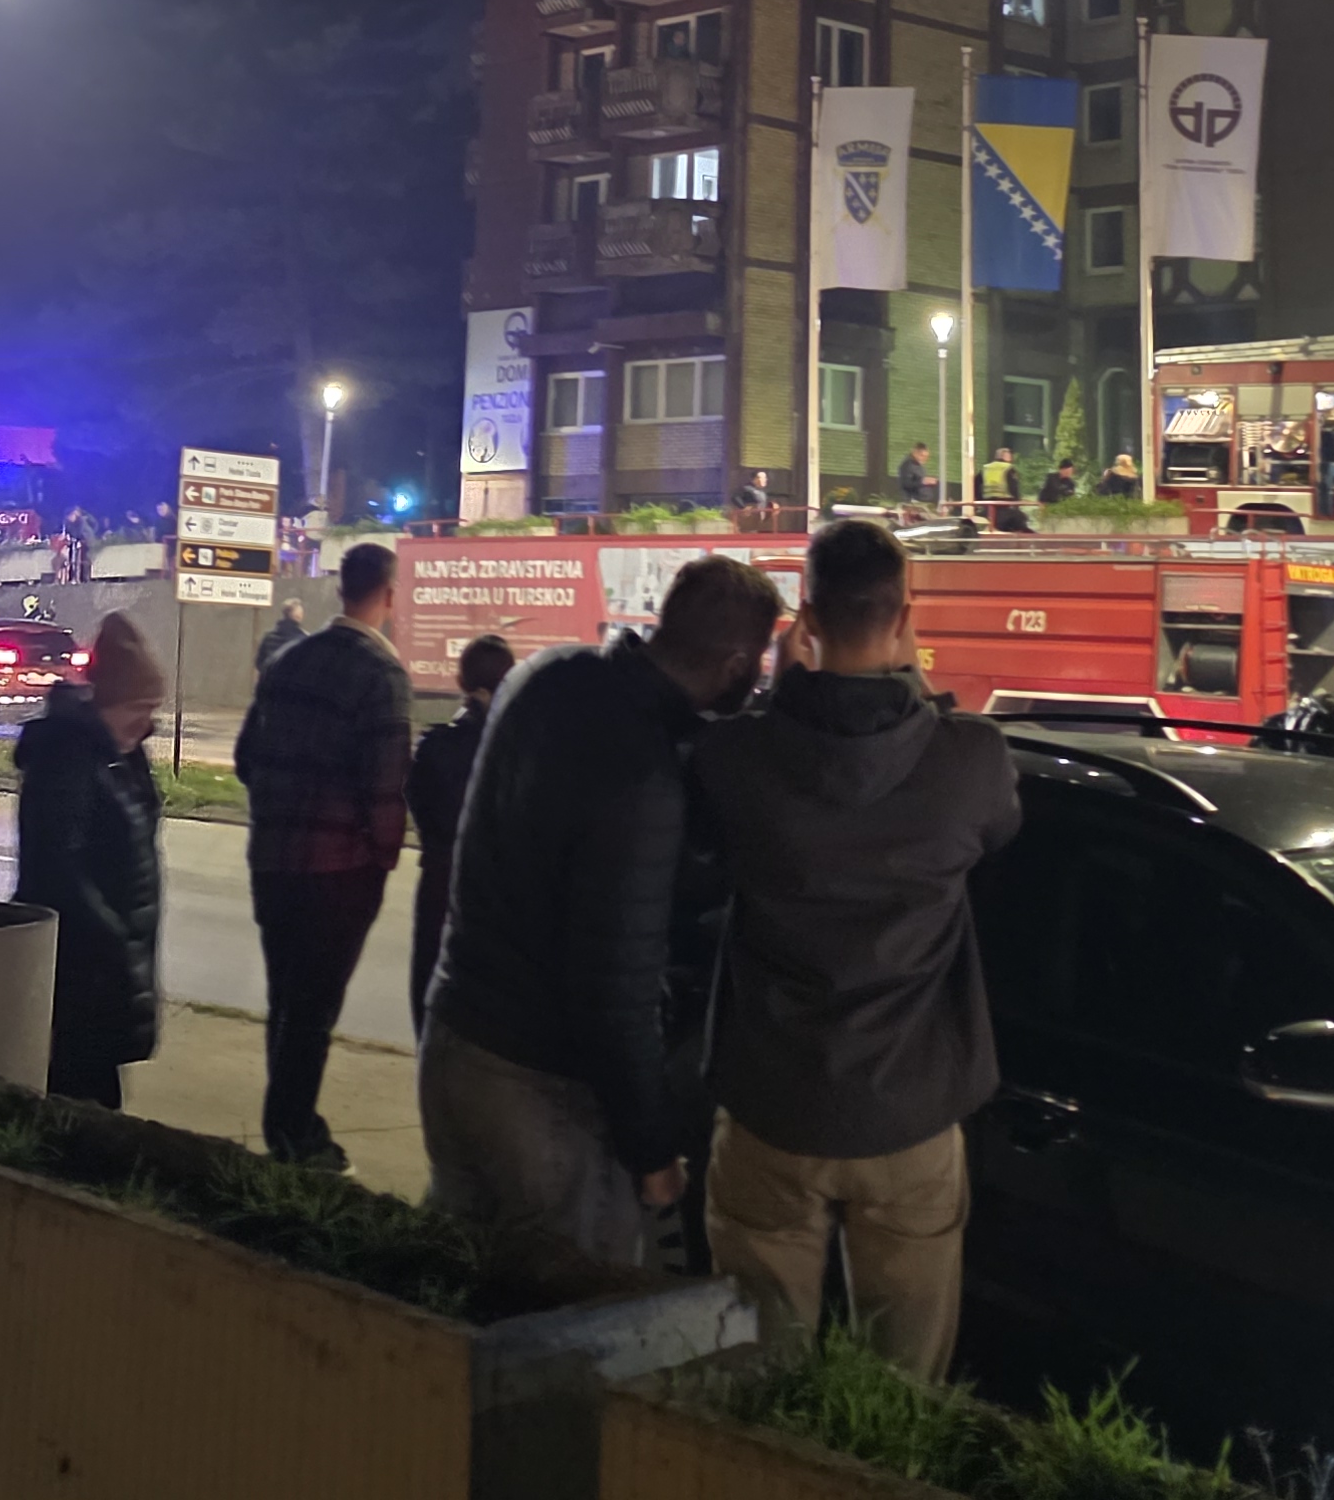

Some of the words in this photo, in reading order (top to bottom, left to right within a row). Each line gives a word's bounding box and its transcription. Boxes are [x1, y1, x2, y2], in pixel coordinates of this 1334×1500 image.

[496, 364, 528, 383] DOM
[472, 391, 530, 410] PENZION
[478, 560, 584, 579] ZDRAVSTVENA
[413, 587, 492, 606] GRUPACIJA
[492, 588, 505, 605] U
[505, 587, 576, 607] TURSKOJ
